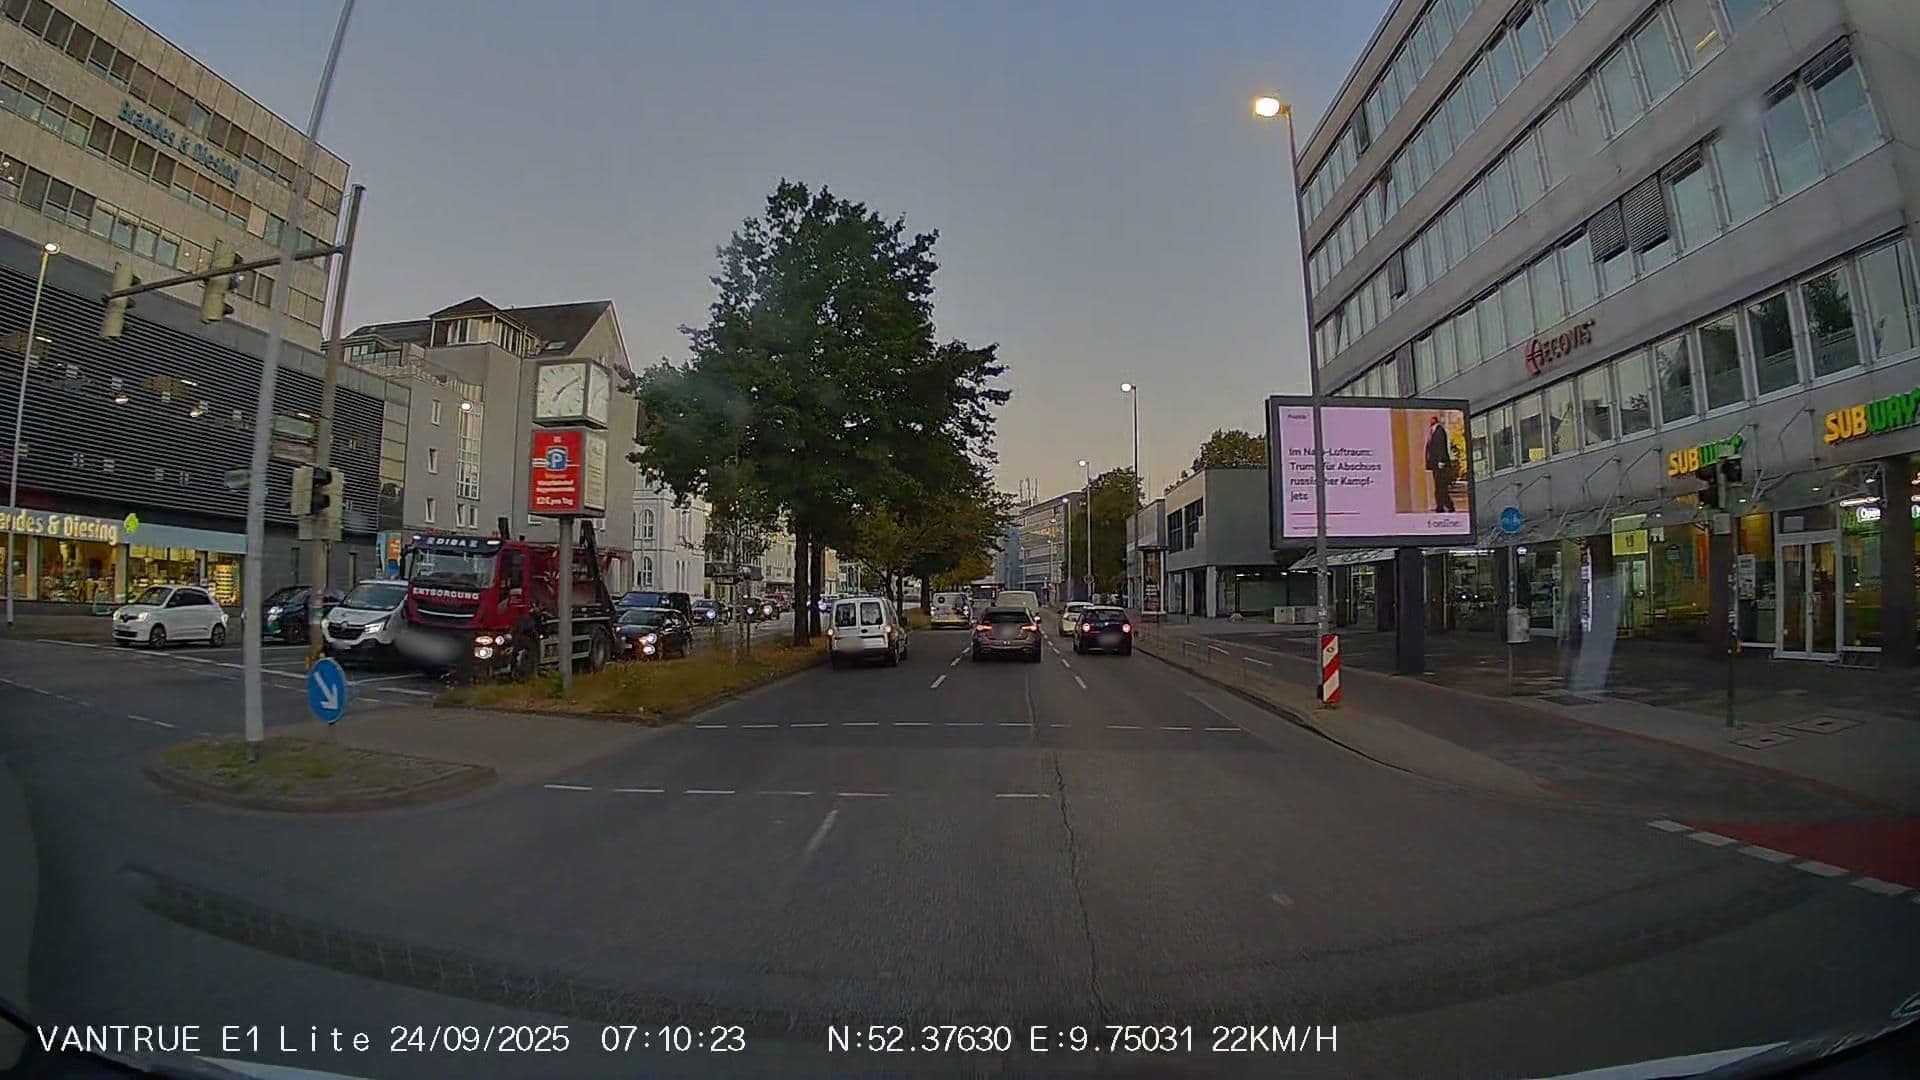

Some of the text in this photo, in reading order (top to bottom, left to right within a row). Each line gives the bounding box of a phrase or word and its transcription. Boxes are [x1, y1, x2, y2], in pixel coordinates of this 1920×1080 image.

[1824, 387, 1920, 444] SUBWAY
[1289, 448, 1301, 456] Im
[1290, 462, 1319, 471] Trum
[47, 514, 60, 535] &
[63, 516, 118, 546] Diesing
